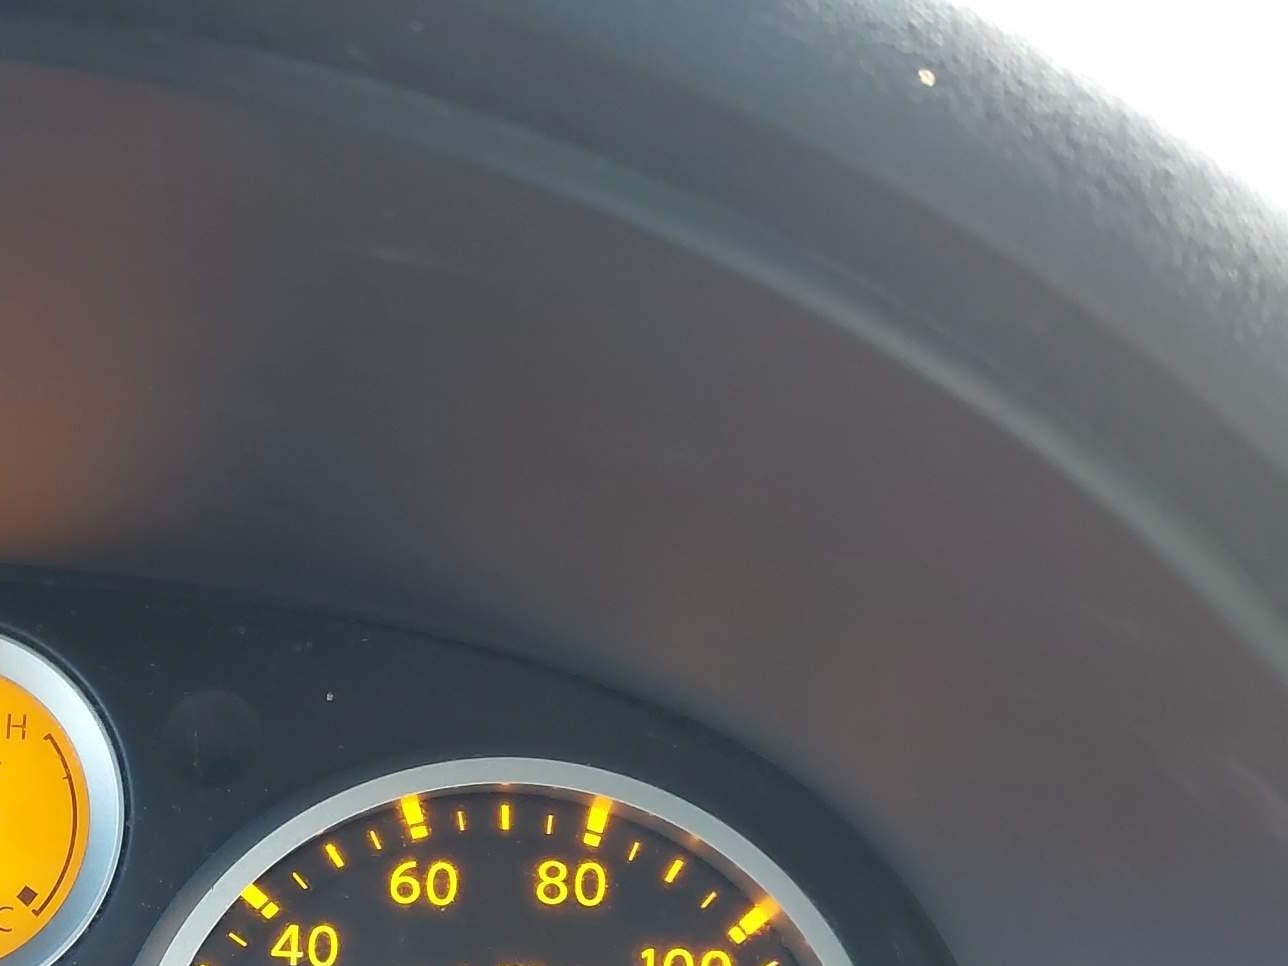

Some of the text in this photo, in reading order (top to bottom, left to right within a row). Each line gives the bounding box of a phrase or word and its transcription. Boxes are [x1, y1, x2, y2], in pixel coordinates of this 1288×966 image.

[6, 714, 27, 739] H
[389, 861, 458, 906] 60
[536, 861, 607, 906] 80
